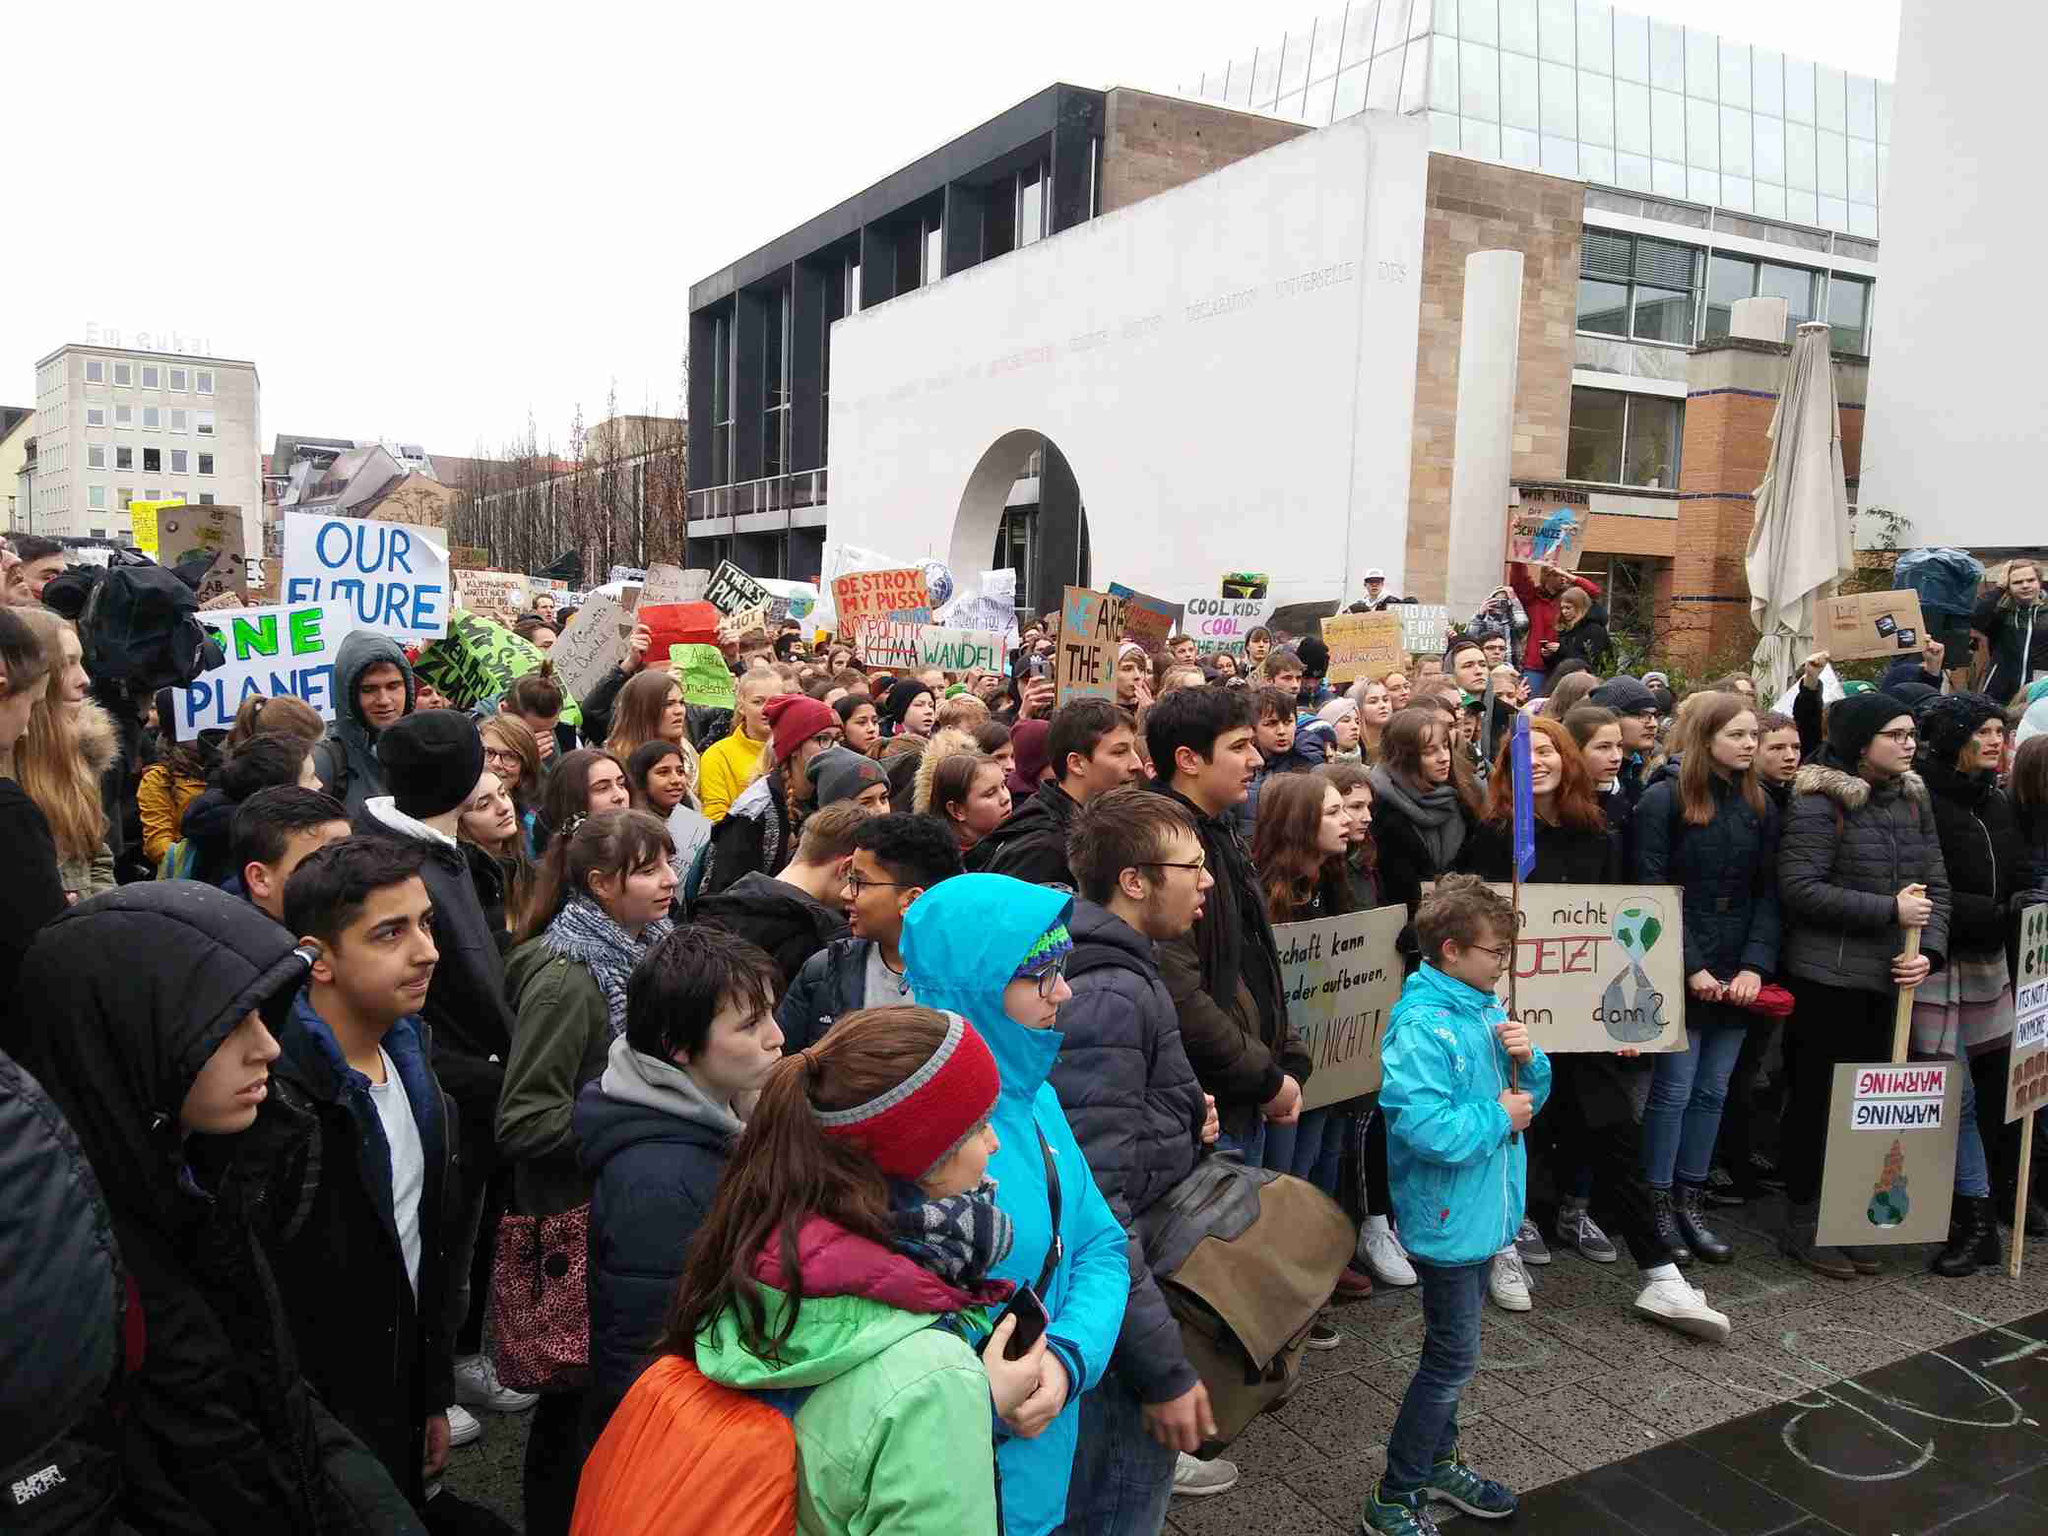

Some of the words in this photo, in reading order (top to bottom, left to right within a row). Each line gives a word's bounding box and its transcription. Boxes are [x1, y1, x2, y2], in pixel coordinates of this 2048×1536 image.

[316, 522, 412, 574] OUR
[838, 571, 918, 596] DESTROY
[842, 594, 869, 614] MY
[876, 590, 927, 610] PUSSY
[1187, 598, 1229, 616] COOL
[1232, 601, 1262, 616] KIDS
[868, 619, 923, 640] POLITIK
[1201, 618, 1242, 636] COOL
[1408, 620, 1434, 635] FOR
[865, 635, 919, 667] KLIMA
[1066, 643, 1101, 683] THE
[1553, 901, 1608, 925] nicht
[1331, 931, 1365, 957] kann
[1322, 968, 1387, 993] aufbauen,
[1320, 1008, 1381, 1069] NICHT!
[1860, 1070, 1943, 1094] WARMING
[1857, 1103, 1940, 1125] WARNING
[11, 1464, 59, 1494] SUPER
